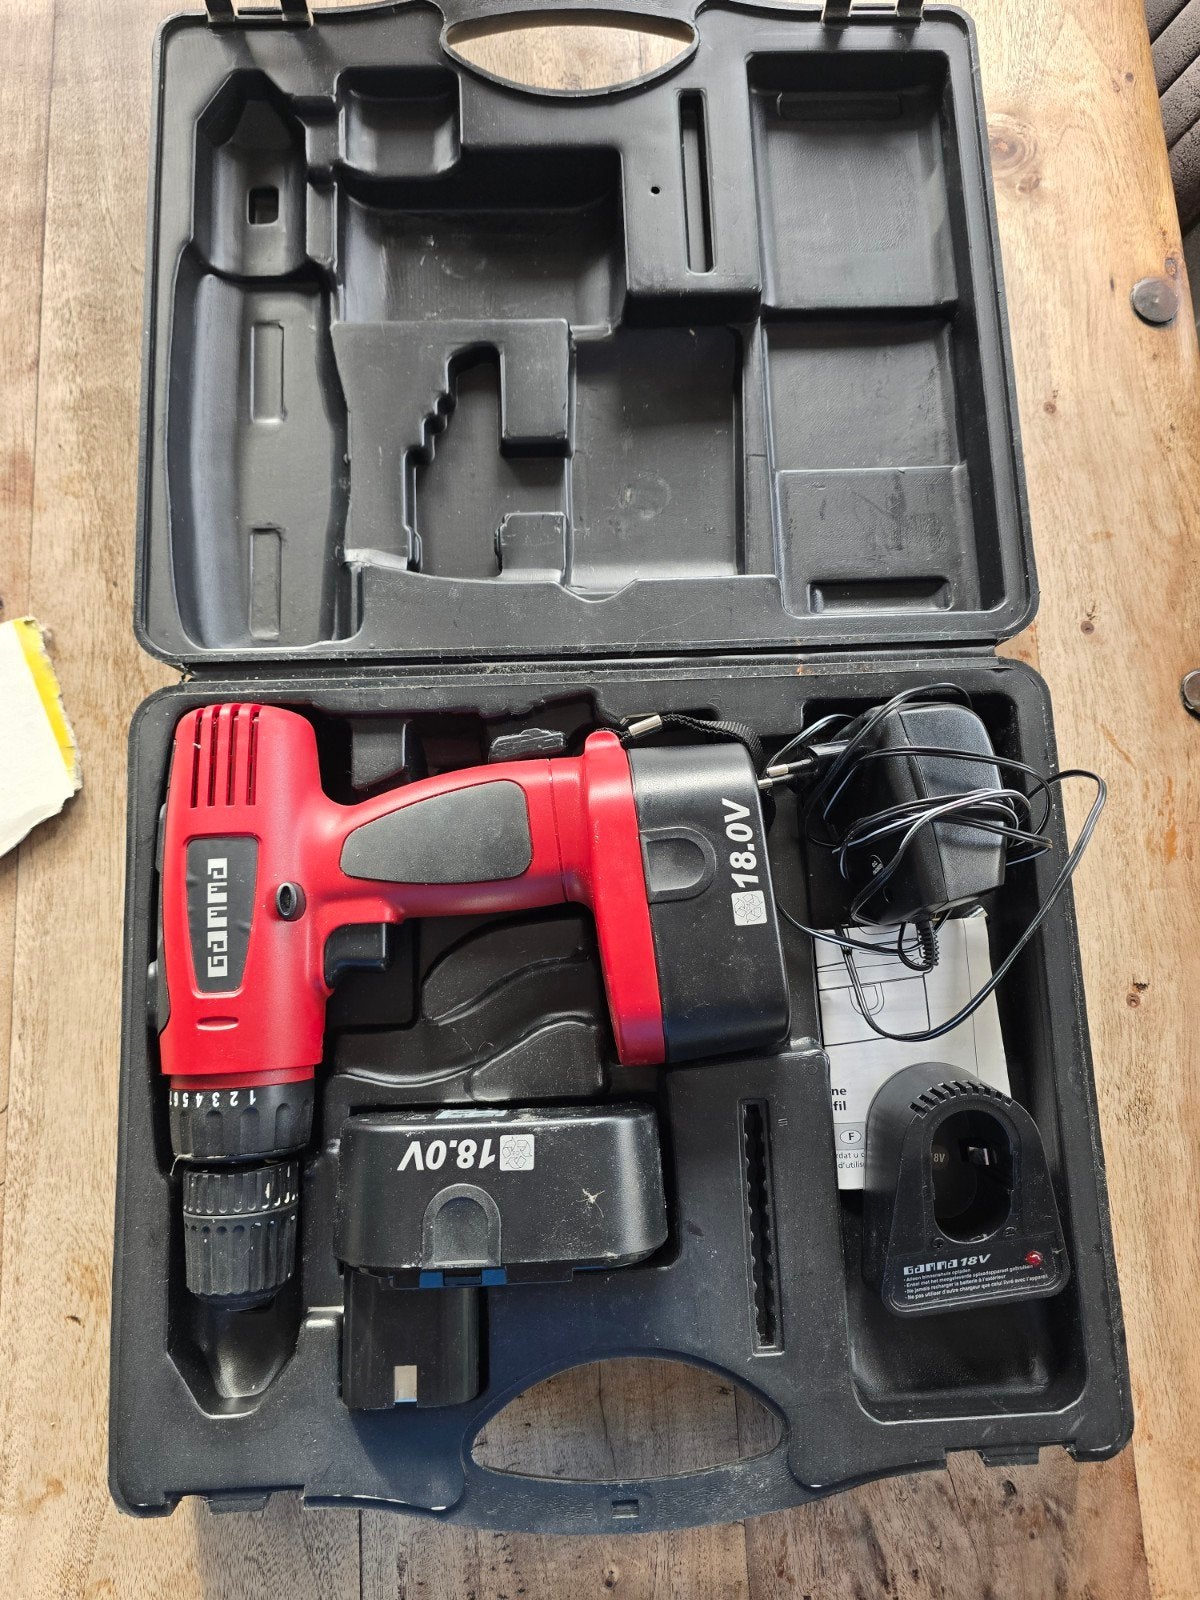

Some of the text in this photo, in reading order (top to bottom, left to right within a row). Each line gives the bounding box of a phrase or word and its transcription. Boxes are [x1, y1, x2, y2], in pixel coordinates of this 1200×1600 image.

[722, 797, 759, 888] 18.0V
[173, 1091, 179, 1107] 6
[182, 1092, 189, 1108] 5
[195, 1092, 204, 1108] 4
[212, 1091, 220, 1108] 3
[230, 1090, 239, 1107] 2
[249, 1089, 257, 1106] 1
[833, 1100, 847, 1111] fil
[848, 1132, 855, 1141] F
[396, 1138, 496, 1171] 18.0V
[931, 1152, 946, 1163] 8V
[960, 1253, 992, 1268] 18V
